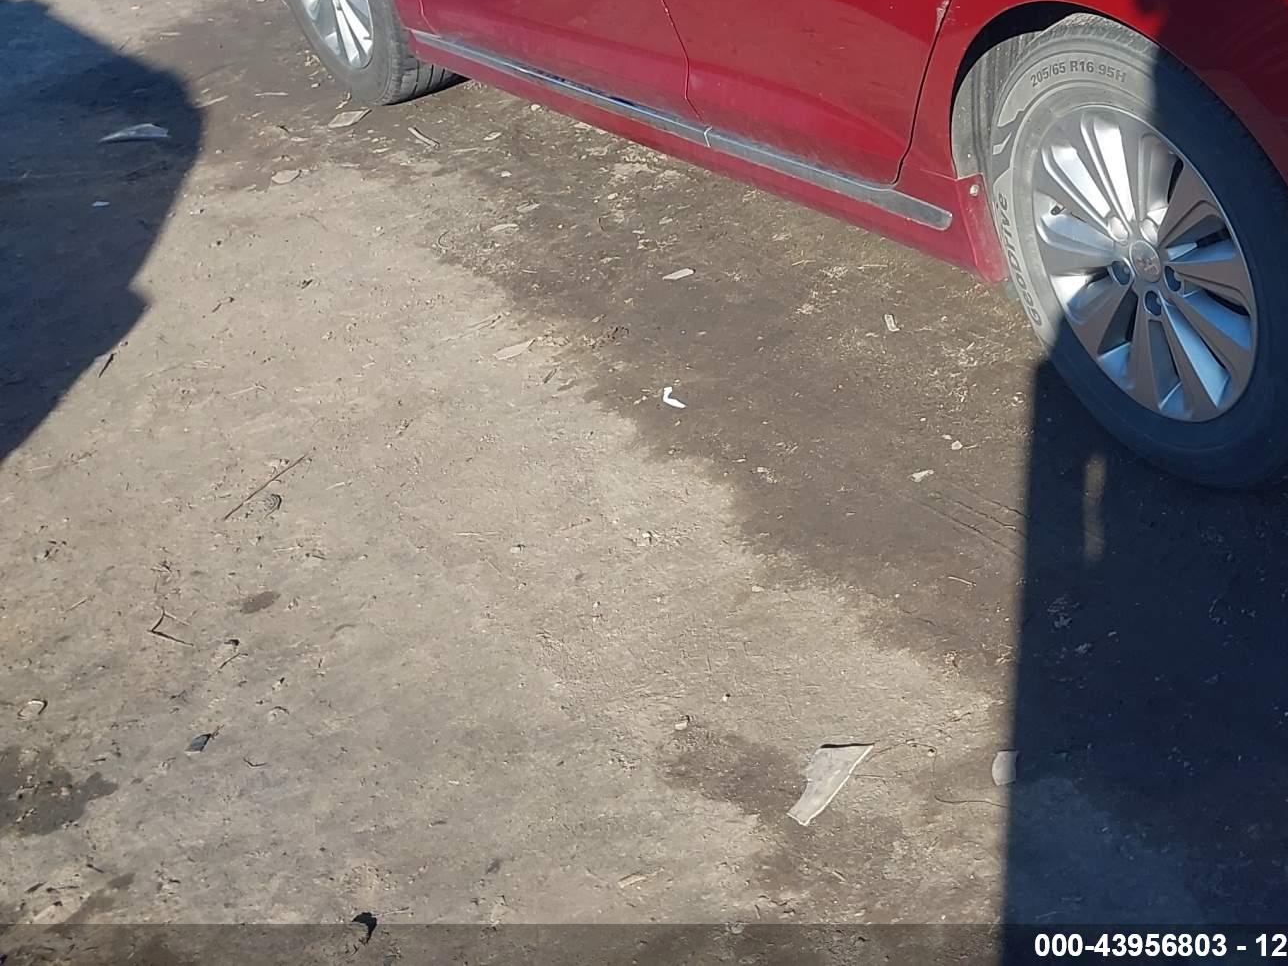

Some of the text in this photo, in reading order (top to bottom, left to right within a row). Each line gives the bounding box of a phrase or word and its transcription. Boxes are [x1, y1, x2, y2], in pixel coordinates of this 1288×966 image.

[1030, 60, 1127, 87] 205/65 R16 95H
